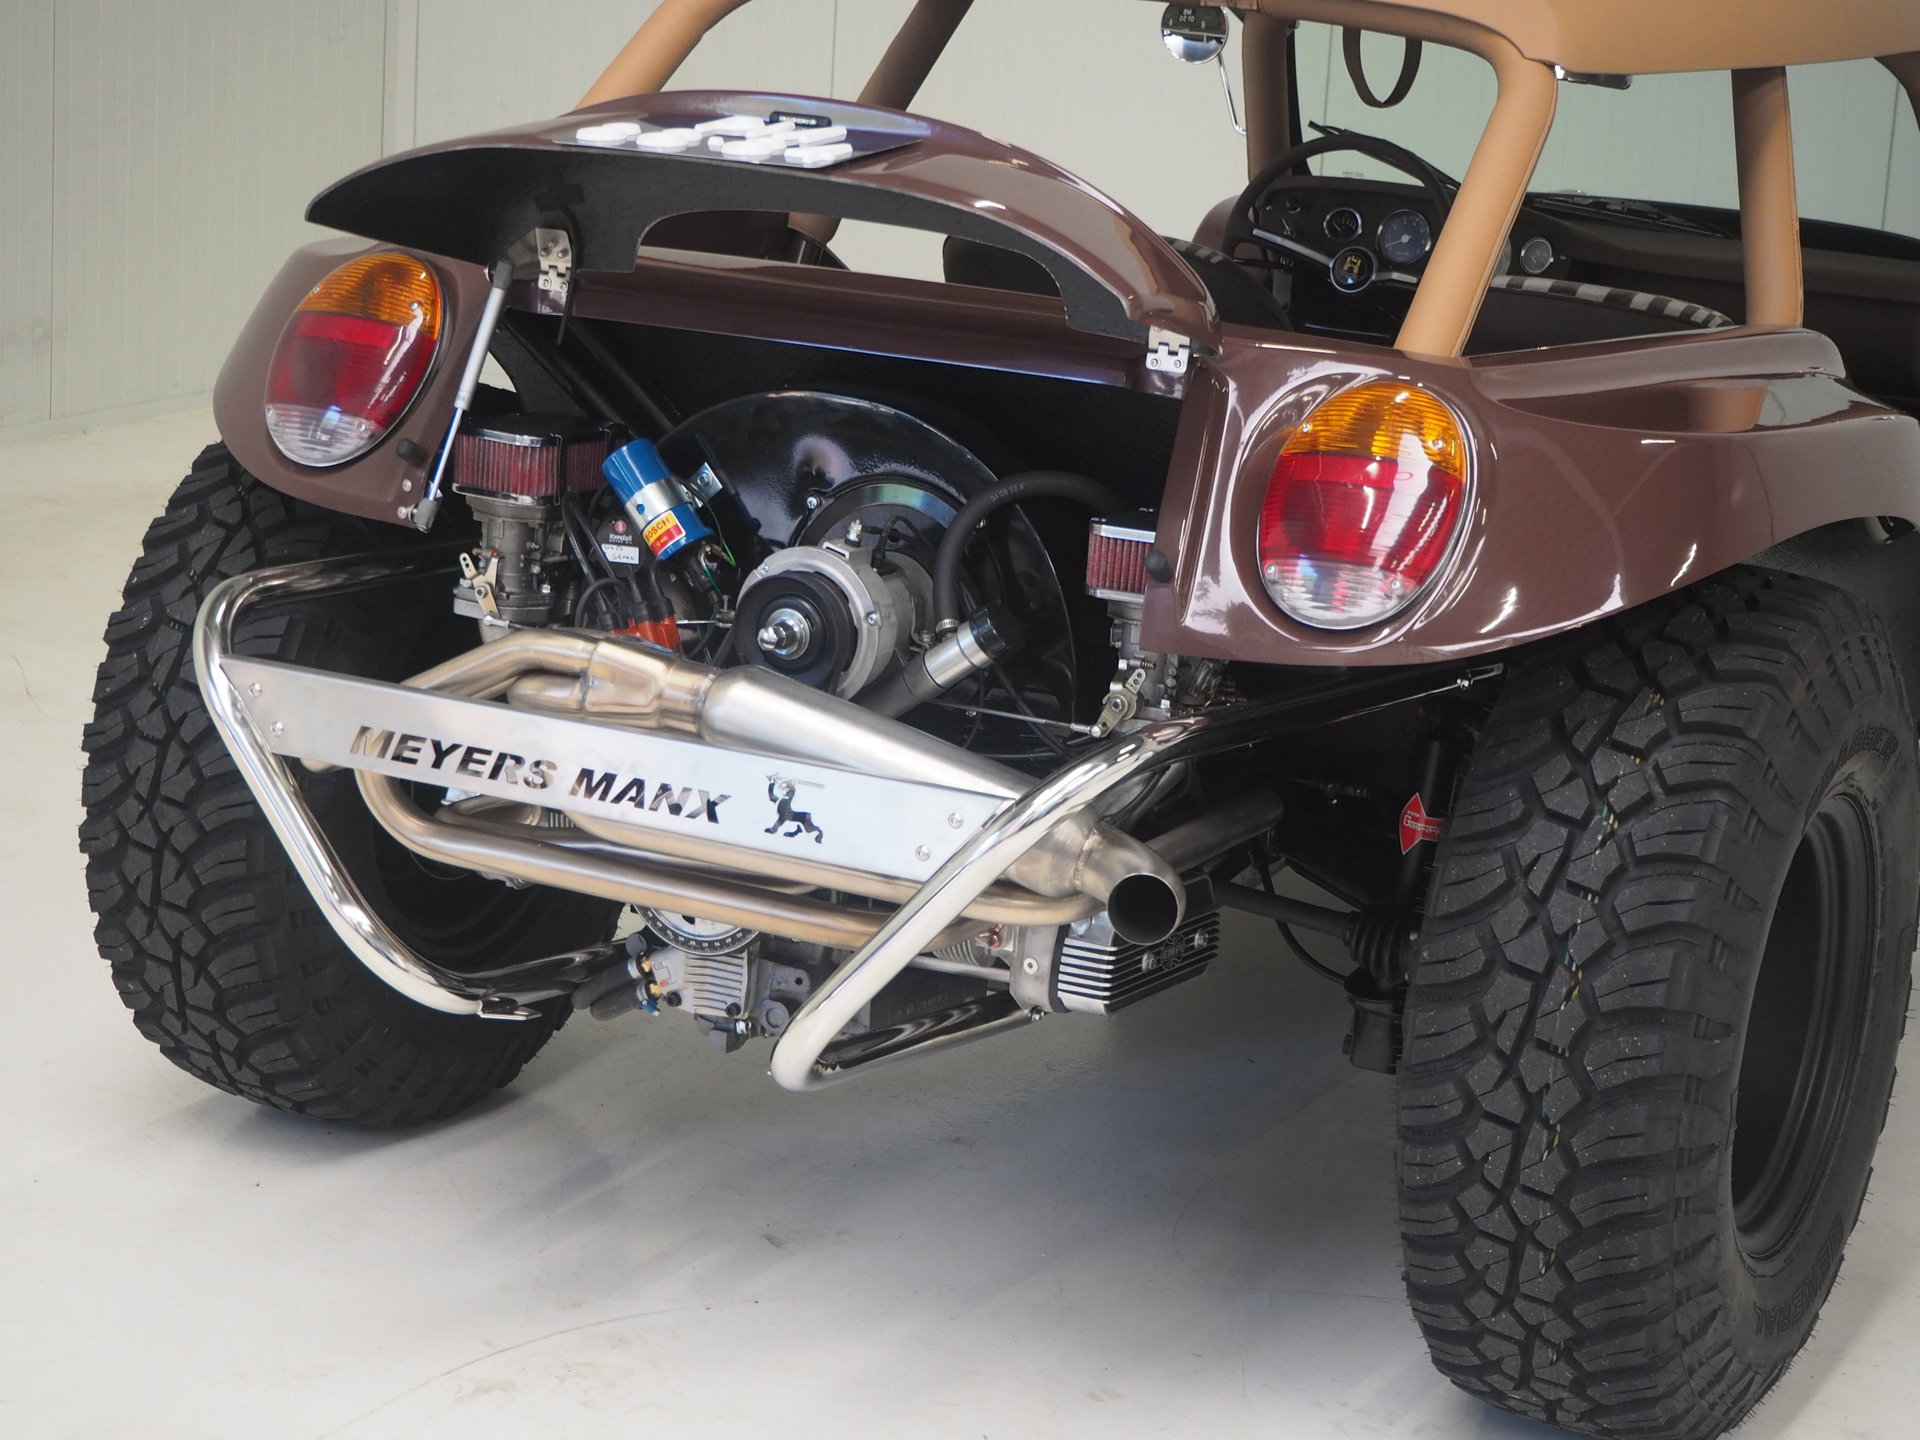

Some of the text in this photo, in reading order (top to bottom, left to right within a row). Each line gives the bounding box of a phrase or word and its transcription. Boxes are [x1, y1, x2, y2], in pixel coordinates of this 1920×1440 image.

[645, 517, 670, 542] BOSCH
[349, 725, 732, 825] MEYERS MANX
[1163, 944, 1185, 960] EMPI
[1753, 1214, 1844, 1338] GENERAL
